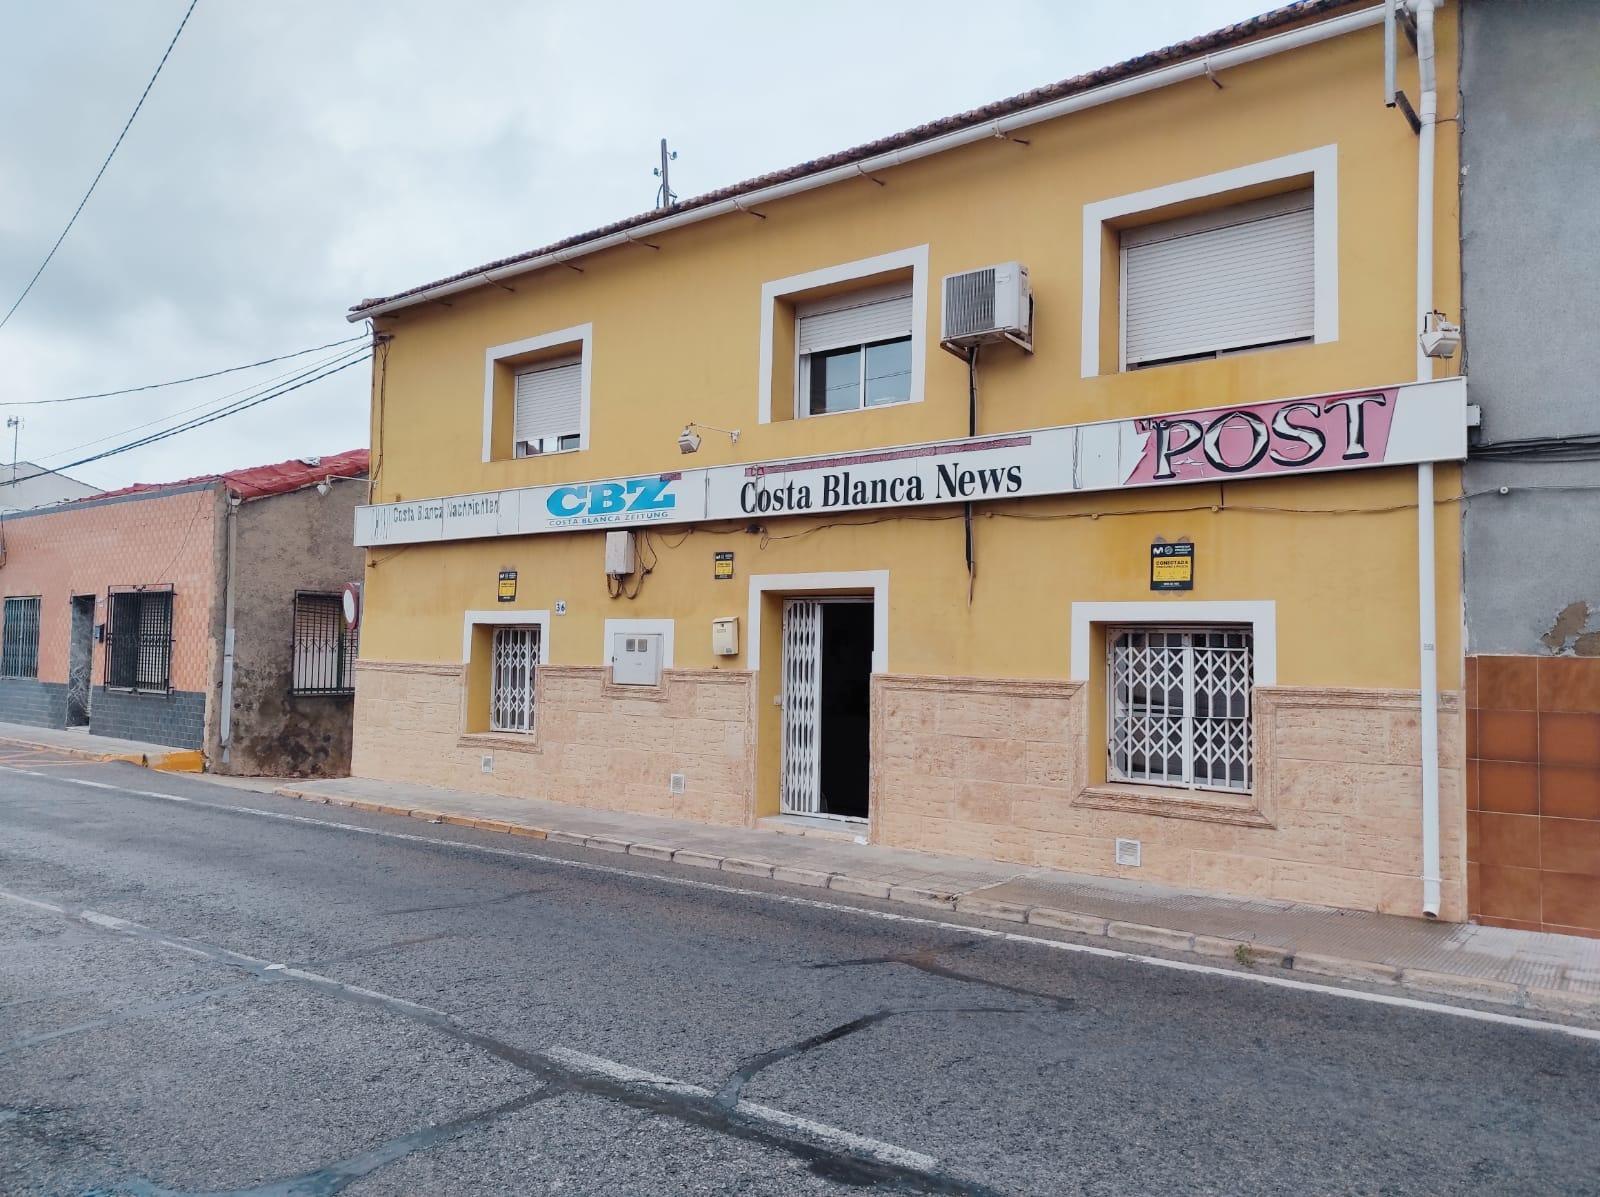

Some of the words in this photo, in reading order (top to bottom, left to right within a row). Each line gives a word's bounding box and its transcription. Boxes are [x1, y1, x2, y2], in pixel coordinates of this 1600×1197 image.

[1152, 392, 1387, 480] POST
[546, 477, 676, 517] CBZ
[740, 478, 812, 514] Costa
[822, 471, 925, 508] Blanca
[936, 462, 1023, 499] News
[393, 506, 415, 523] Costa
[418, 504, 444, 521] Blanca
[549, 518, 579, 527] COSTA
[581, 515, 621, 525] BLANCA
[624, 511, 669, 521] ZEITUNG
[557, 602, 566, 612] 36
